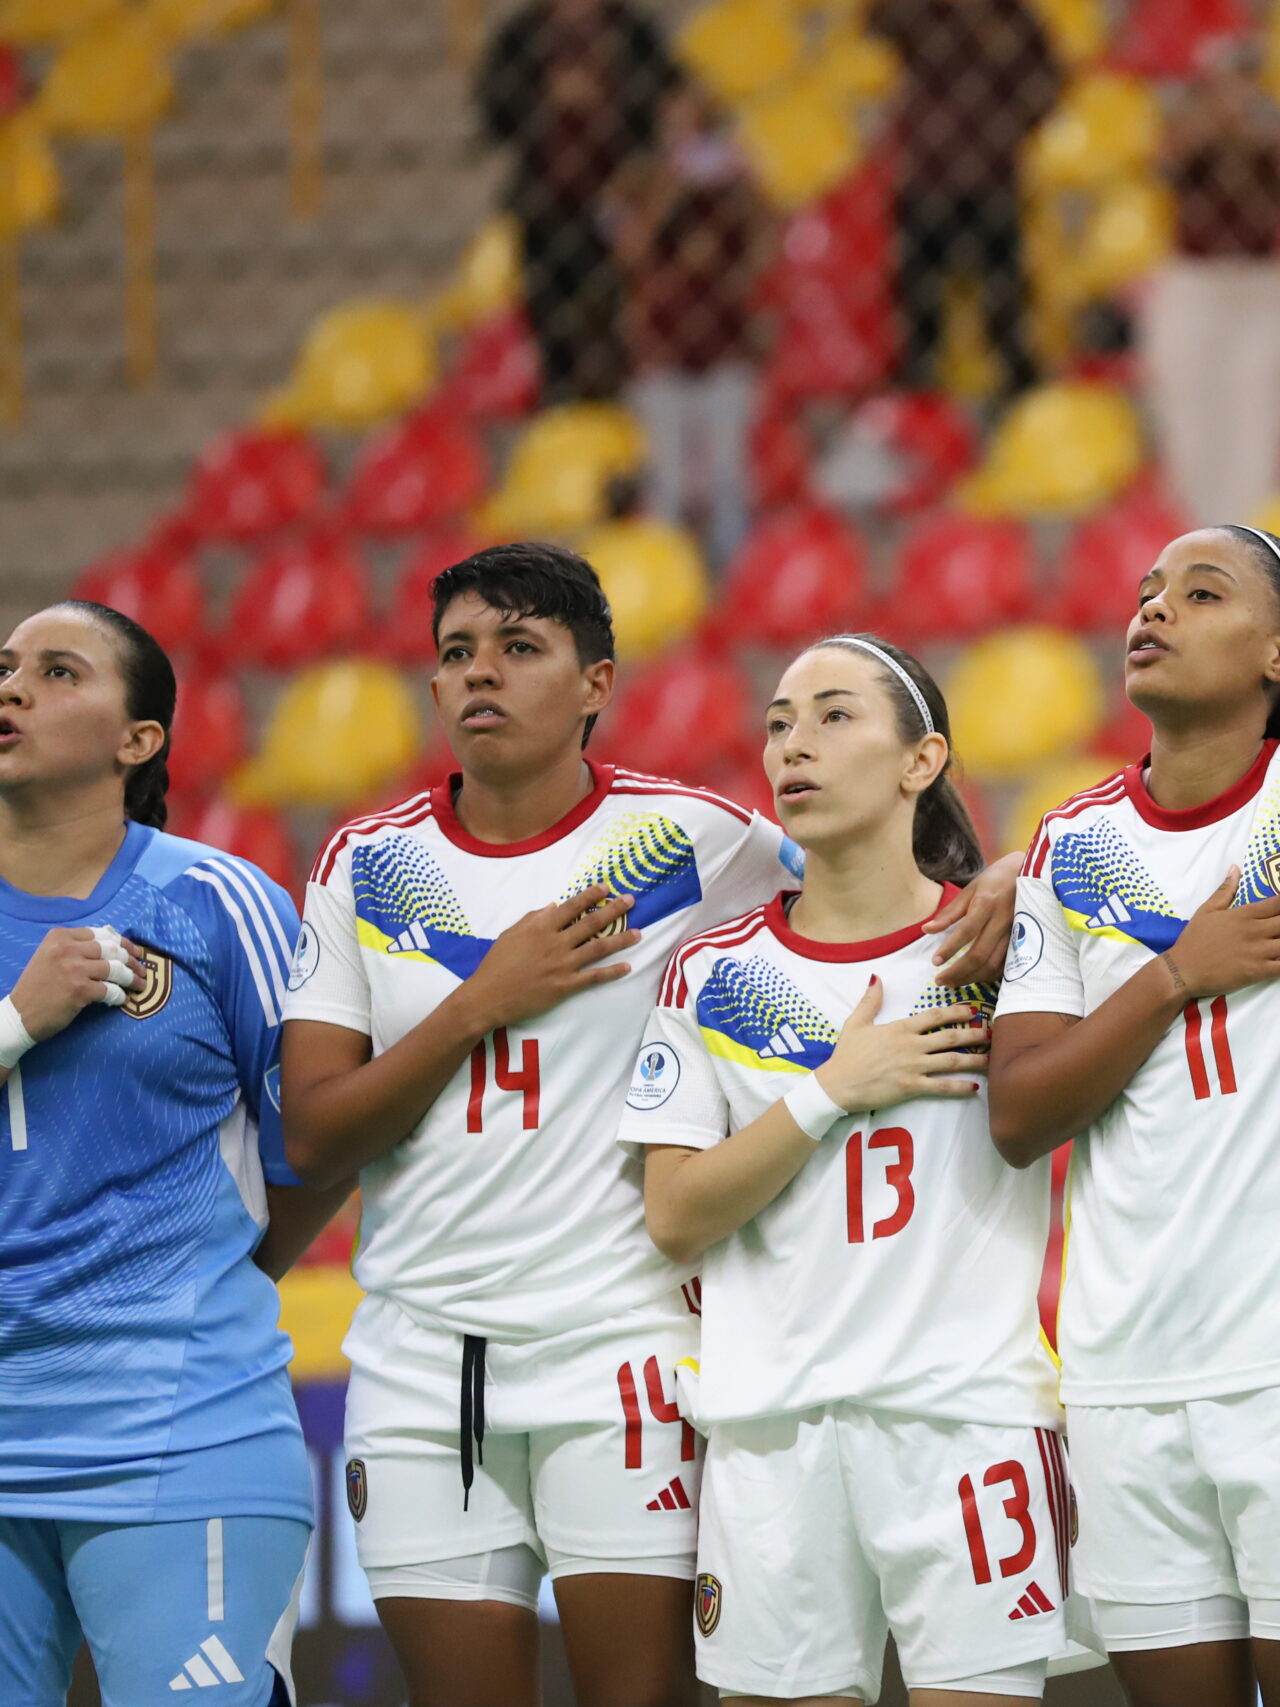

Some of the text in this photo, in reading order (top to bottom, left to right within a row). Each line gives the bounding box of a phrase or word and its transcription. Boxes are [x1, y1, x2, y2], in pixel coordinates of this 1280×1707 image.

[467, 1028, 540, 1134] 14
[1186, 998, 1237, 1100] 11
[846, 1128, 915, 1243] 13
[617, 1355, 695, 1469] 14
[205, 1517, 225, 1621] 1
[959, 1460, 1036, 1586] 13
